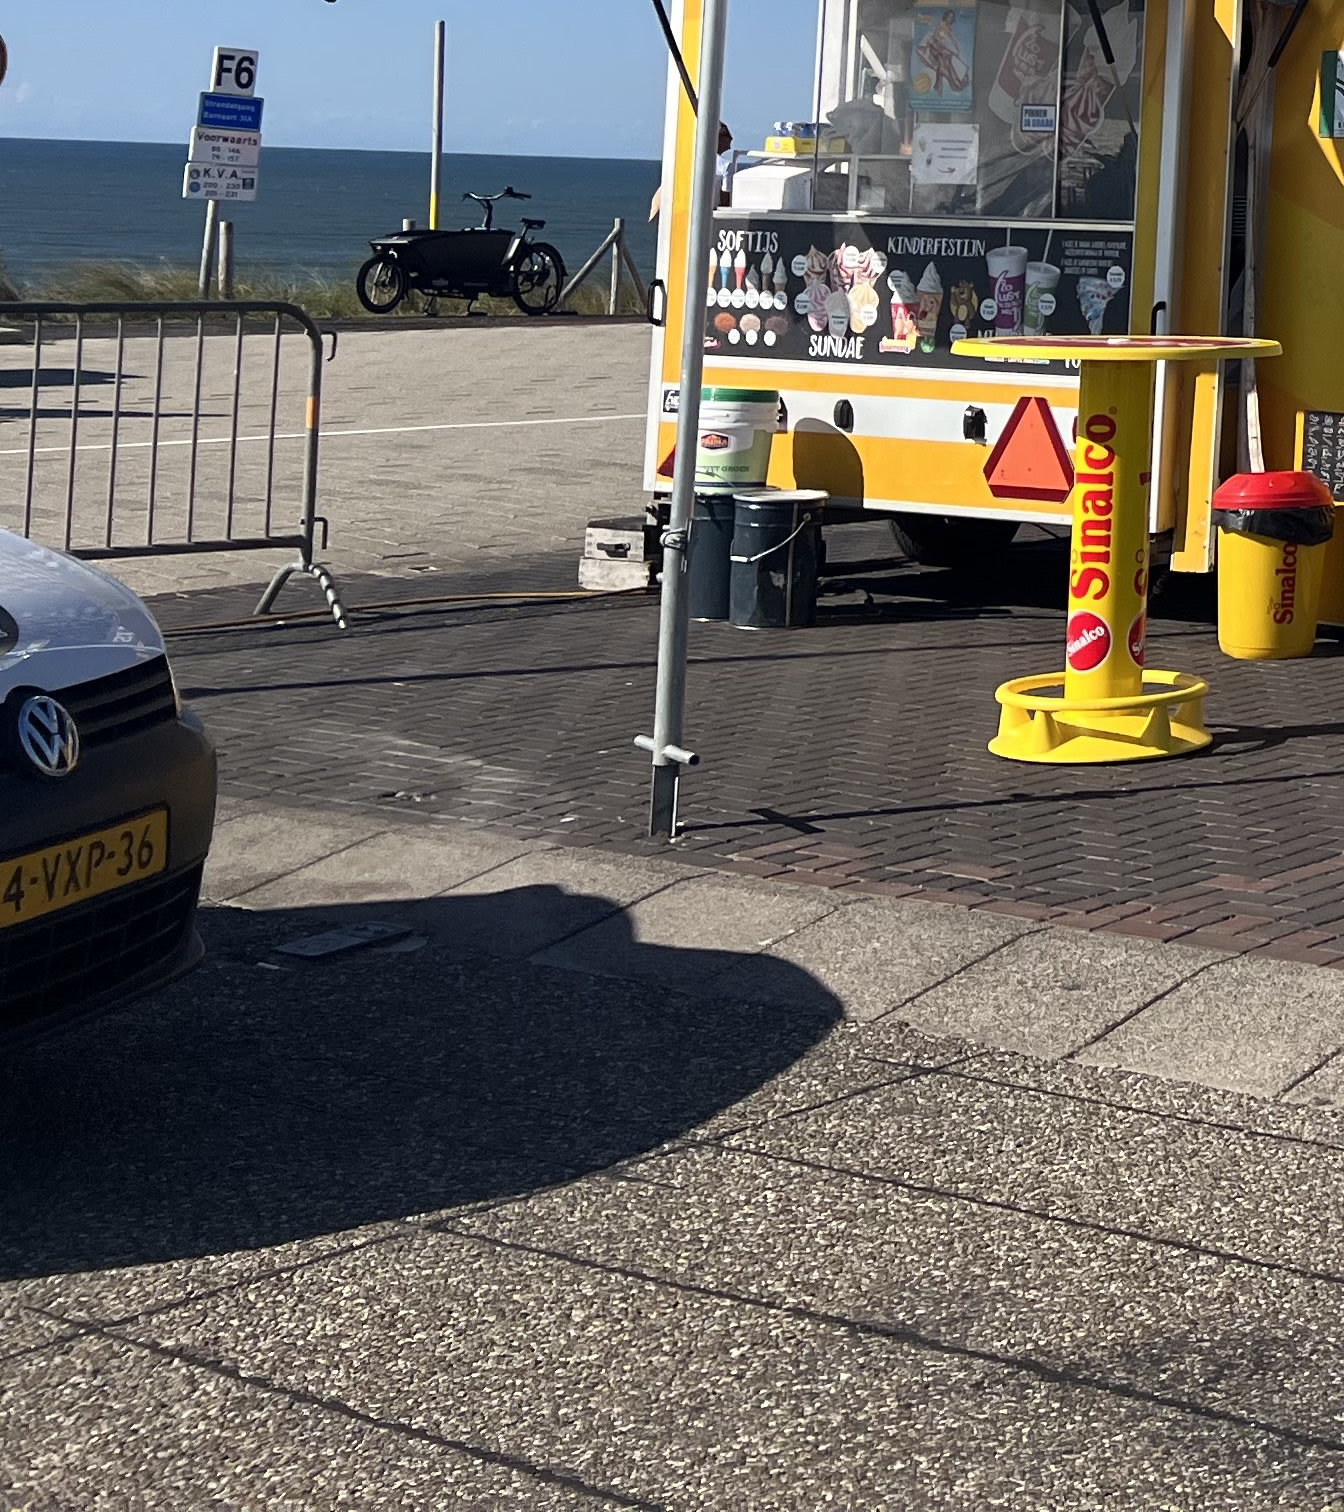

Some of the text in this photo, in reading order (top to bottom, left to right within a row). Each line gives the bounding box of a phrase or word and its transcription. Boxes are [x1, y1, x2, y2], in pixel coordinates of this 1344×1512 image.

[216, 54, 256, 90] F6
[197, 132, 258, 146] Voorwaarts
[717, 229, 779, 253] SOFTIJS
[887, 236, 986, 257] KINDERFESTIJN
[808, 334, 866, 360] SUNDAE
[1070, 412, 1118, 601] Sinalco
[1272, 541, 1298, 625] Sinalco
